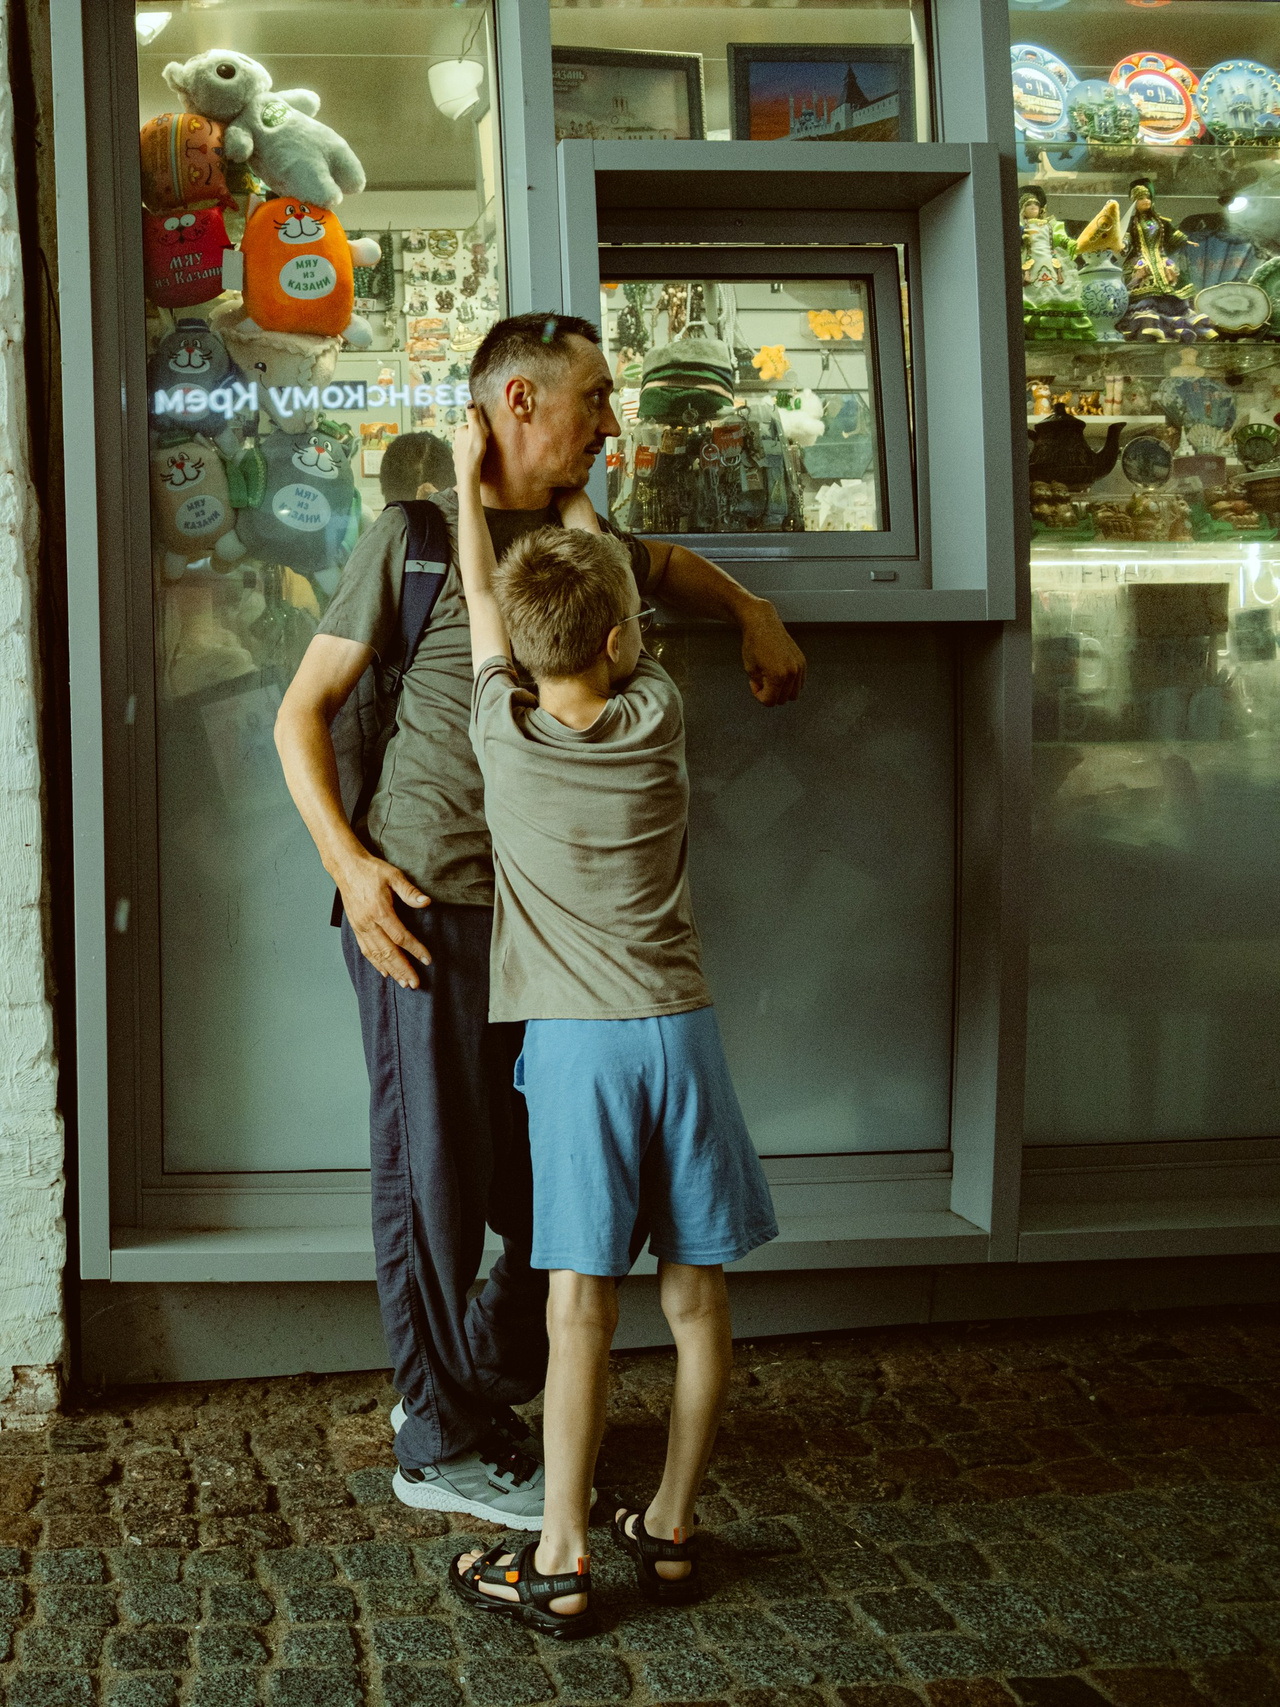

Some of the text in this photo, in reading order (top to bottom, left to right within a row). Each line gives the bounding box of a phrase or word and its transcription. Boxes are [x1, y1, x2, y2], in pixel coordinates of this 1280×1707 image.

[553, 70, 585, 80] АЗАНЬ
[295, 259, 319, 270] МЯУ
[287, 276, 331, 291] КАЗАНИ
[294, 487, 319, 502] МЯУ
[186, 498, 206, 511] МЯУ
[278, 501, 322, 523] КЗАНИ
[183, 510, 221, 529] КАЗАНИ
